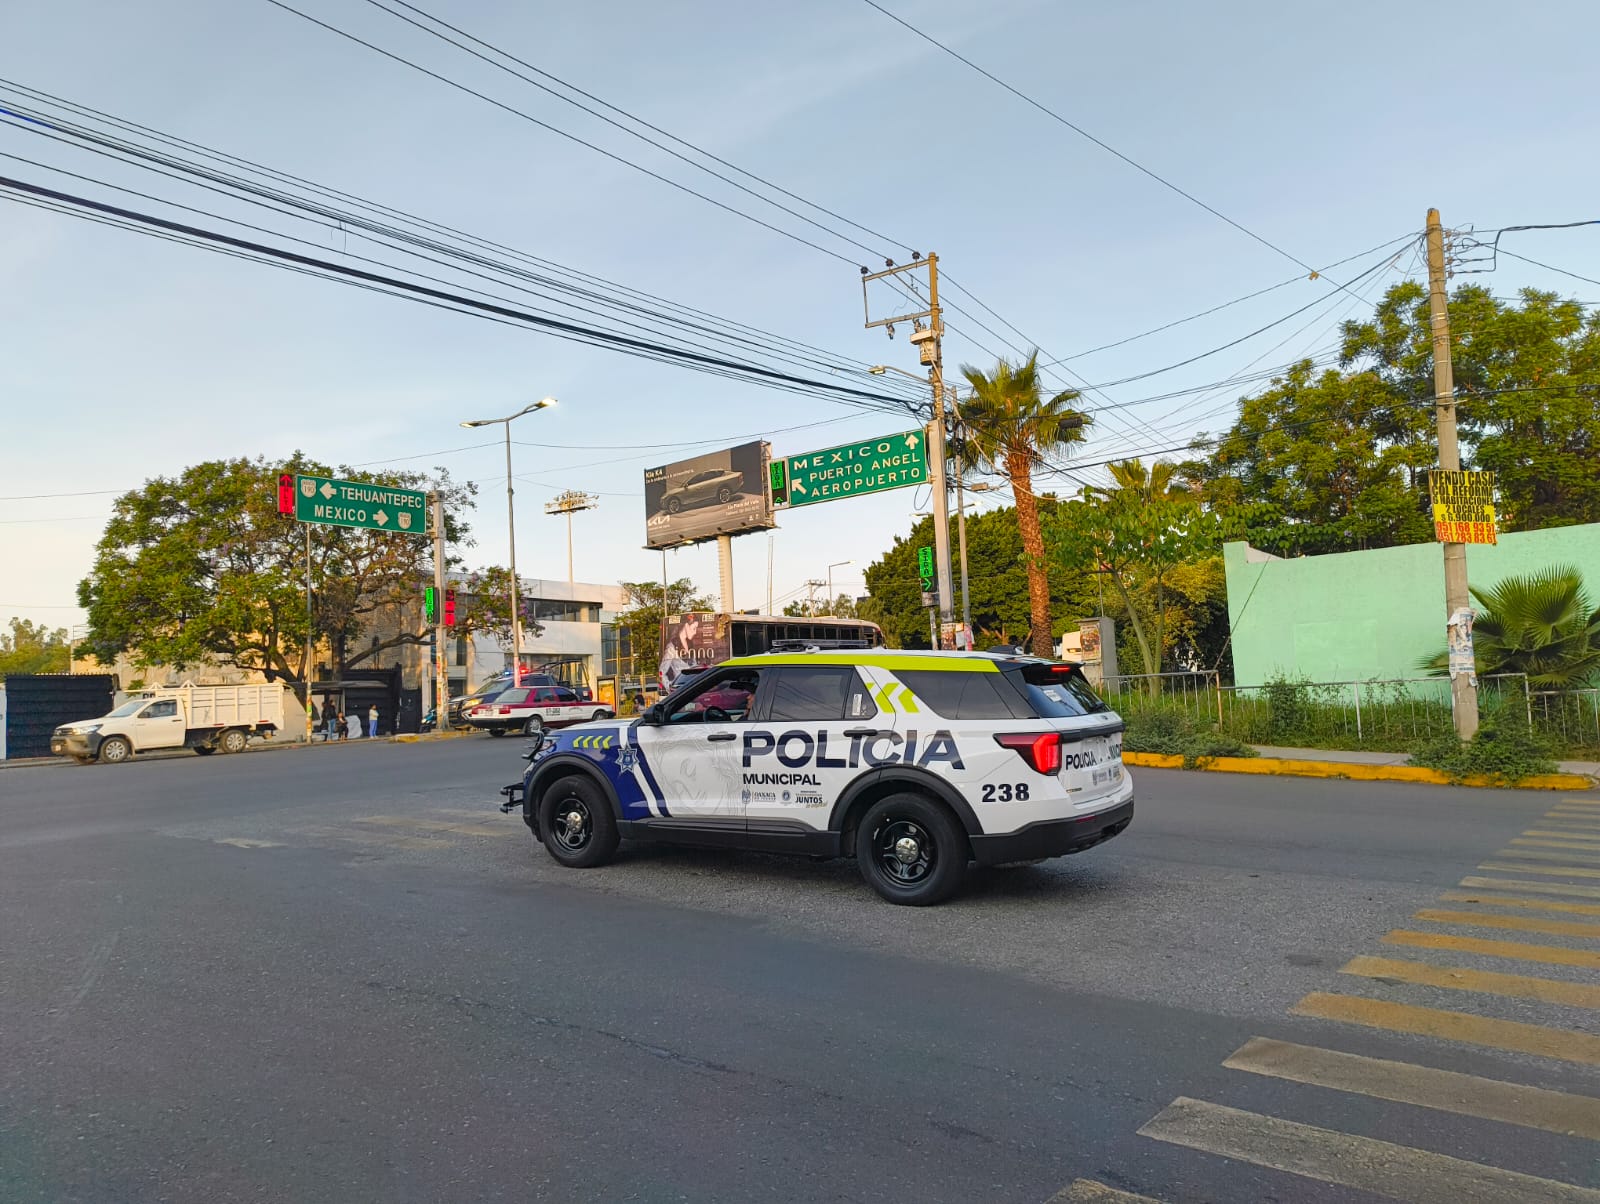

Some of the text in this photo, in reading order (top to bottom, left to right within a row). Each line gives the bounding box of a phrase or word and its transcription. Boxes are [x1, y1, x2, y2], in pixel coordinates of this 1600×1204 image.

[793, 442, 891, 471] MEXICO
[810, 452, 920, 483] PUERTO ANGEL
[811, 467, 920, 498] AEROPUERTO
[1431, 471, 1494, 487] VENDO CASA
[339, 486, 423, 509] TEHUANTEPEC
[1432, 485, 1494, 497] COL REFORMA
[314, 504, 367, 522] MEXICO
[1445, 505, 1485, 514] 2 LOCALES
[742, 729, 966, 770] POLICIA
[1065, 750, 1098, 771] POLICIA
[742, 773, 822, 786] MUNICIPAL
[795, 796, 824, 804] JUNTOS
[981, 783, 1030, 803] 238
